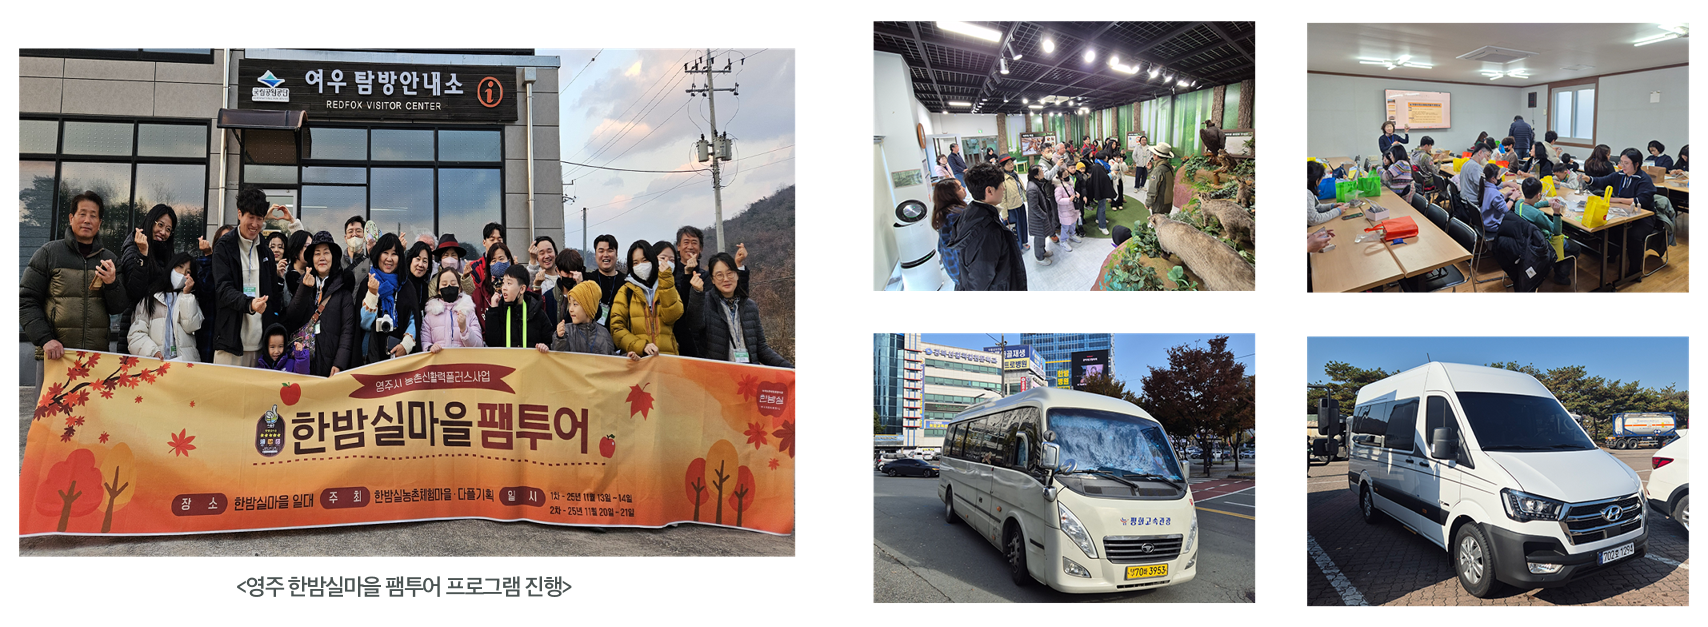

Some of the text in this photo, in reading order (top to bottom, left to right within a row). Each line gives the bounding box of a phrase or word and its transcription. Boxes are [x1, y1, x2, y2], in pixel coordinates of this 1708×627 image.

[305, 68, 464, 97] 여우 탐방안내소
[252, 88, 289, 97] 국립공원공단
[326, 100, 442, 111] REDFOX VISITOR CENTER
[375, 370, 491, 393] 영주시 농촌신활력플러스사업
[234, 493, 314, 511] 한밤실마을 일대
[550, 491, 560, 501] 1차
[566, 492, 581, 502] 25년
[583, 492, 595, 502] 11월
[597, 493, 611, 502] 13일
[550, 506, 561, 515] 2차
[568, 506, 583, 516] 25년
[584, 507, 598, 516] 11월
[599, 507, 614, 517] 20일
[1130, 517, 1171, 526] 평화고속관광
[1148, 565, 1166, 576] 3953
